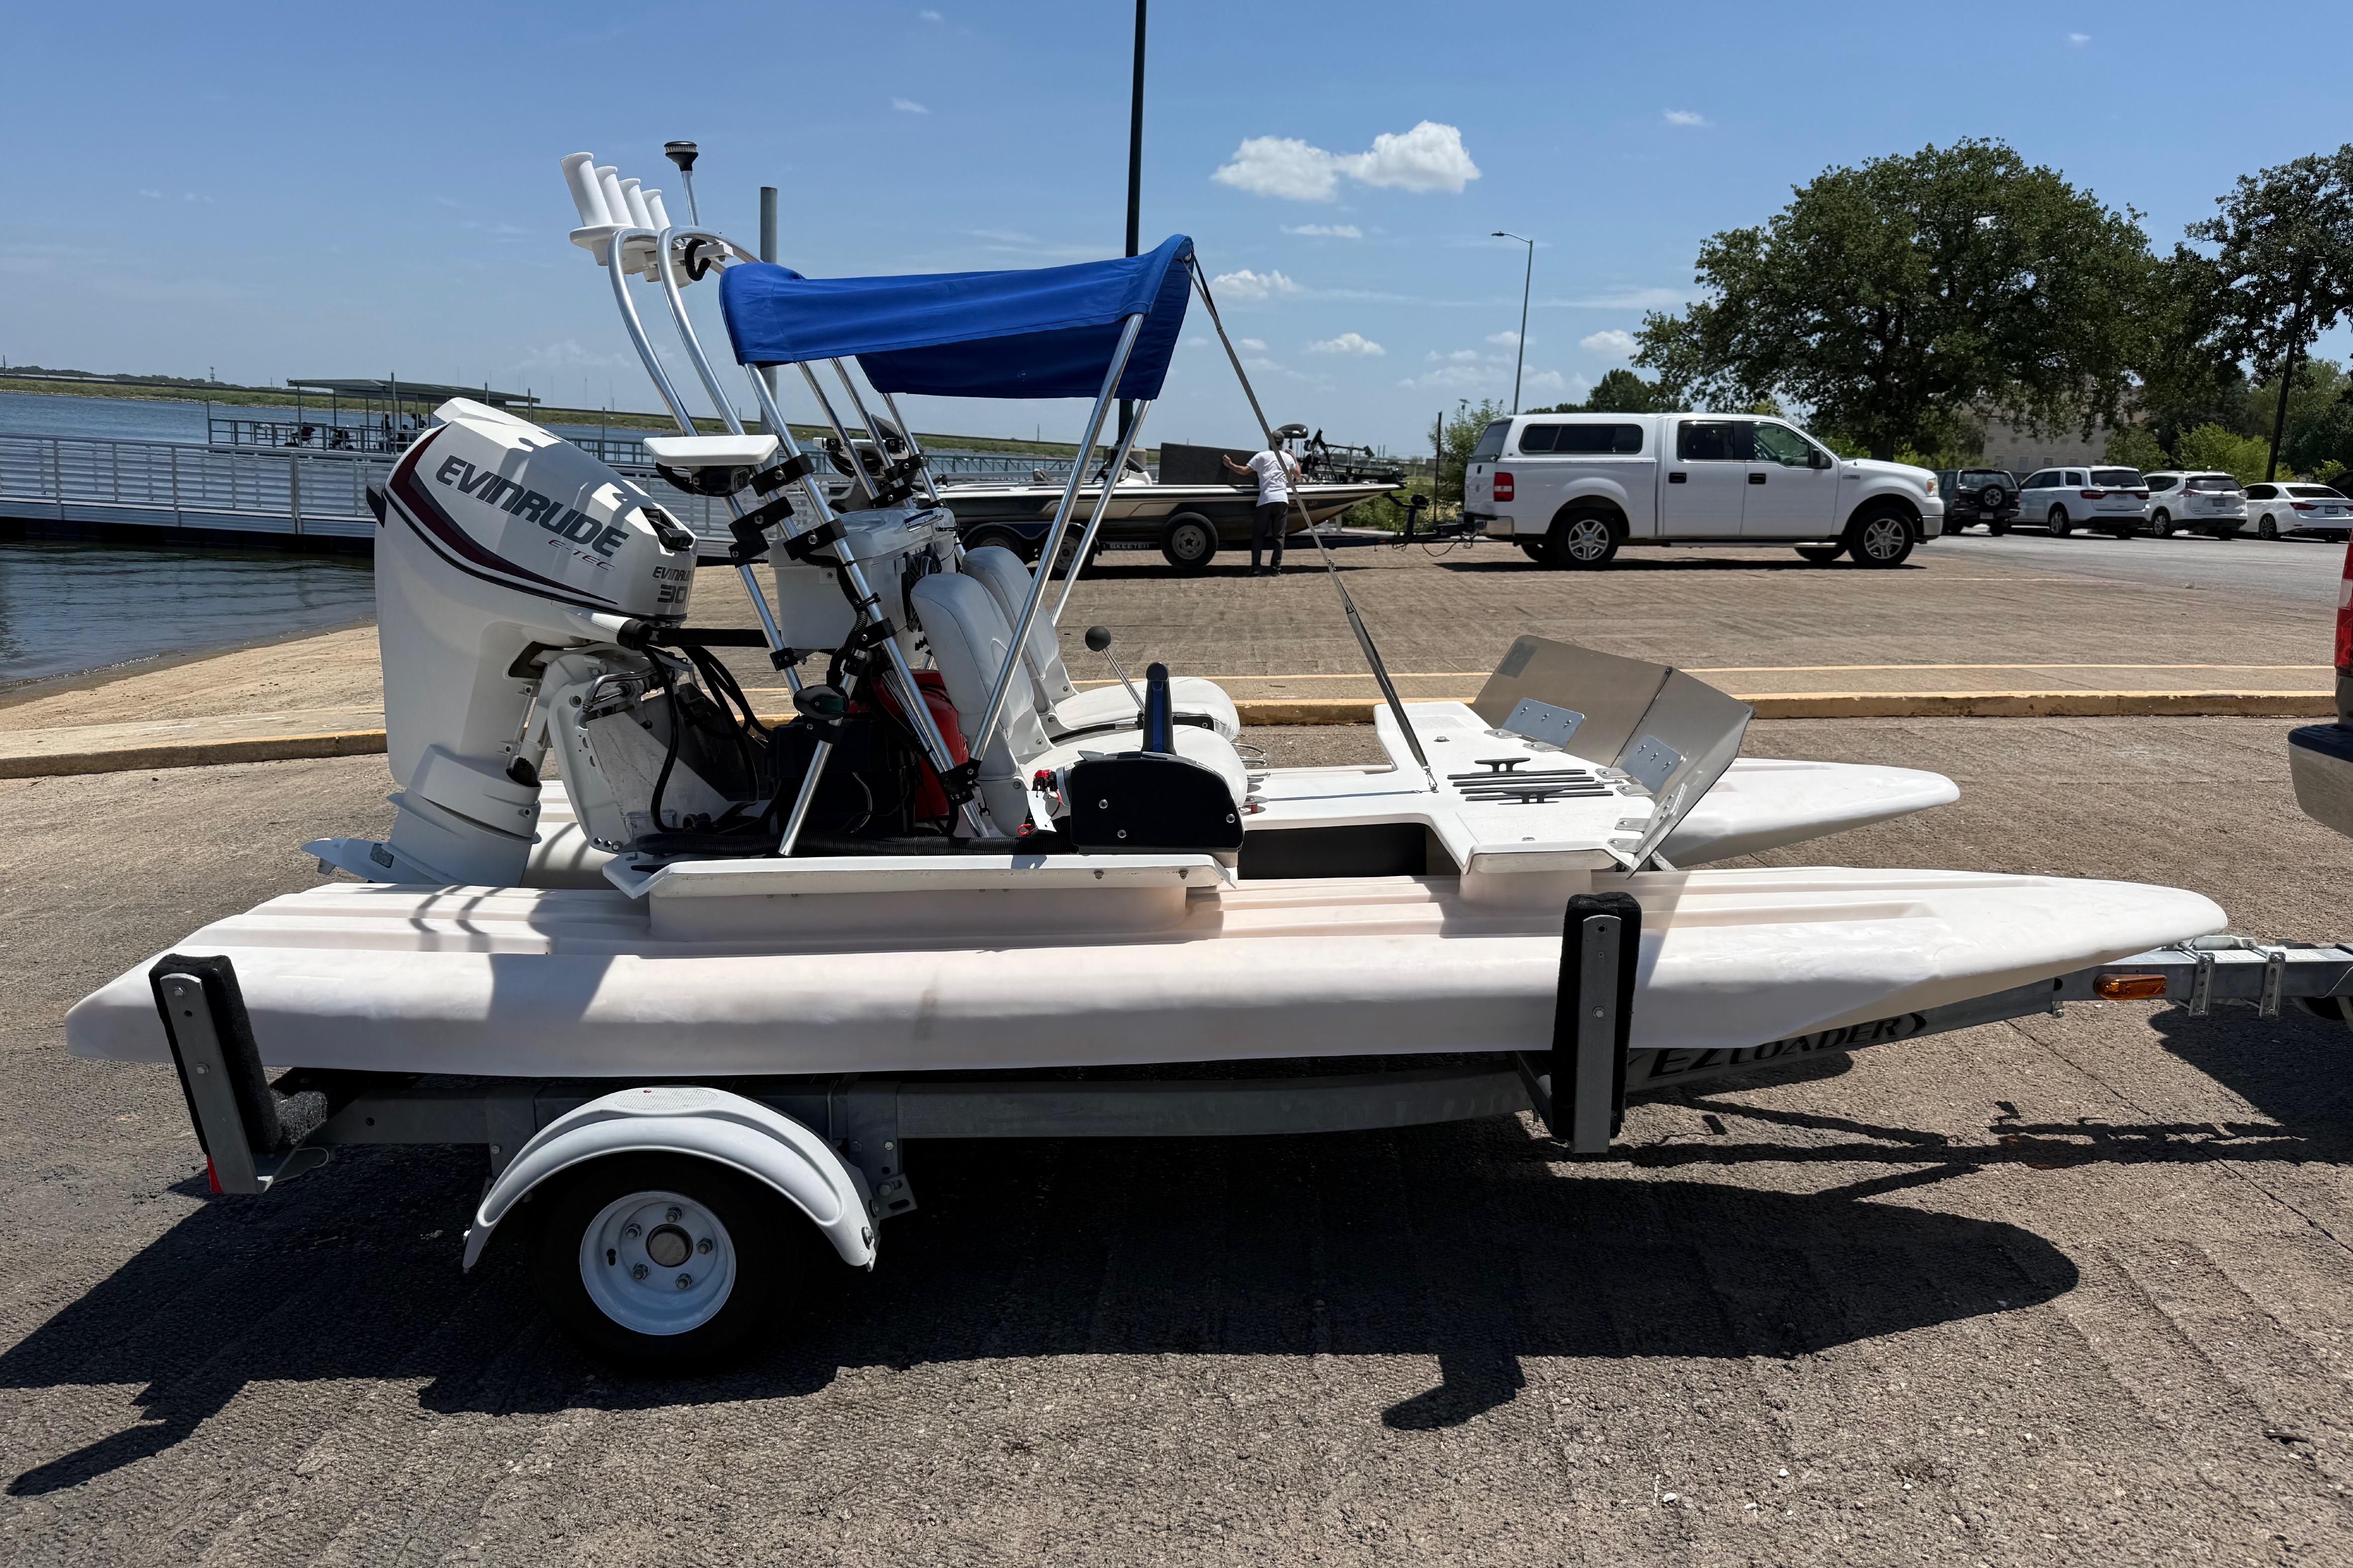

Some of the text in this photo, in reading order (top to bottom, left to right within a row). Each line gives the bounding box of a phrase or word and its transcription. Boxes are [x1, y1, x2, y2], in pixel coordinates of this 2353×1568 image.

[436, 455, 630, 558] EVINRUDE
[548, 540, 616, 571] E-TEC
[652, 566, 693, 581] EVINRU
[657, 584, 688, 604] 30
